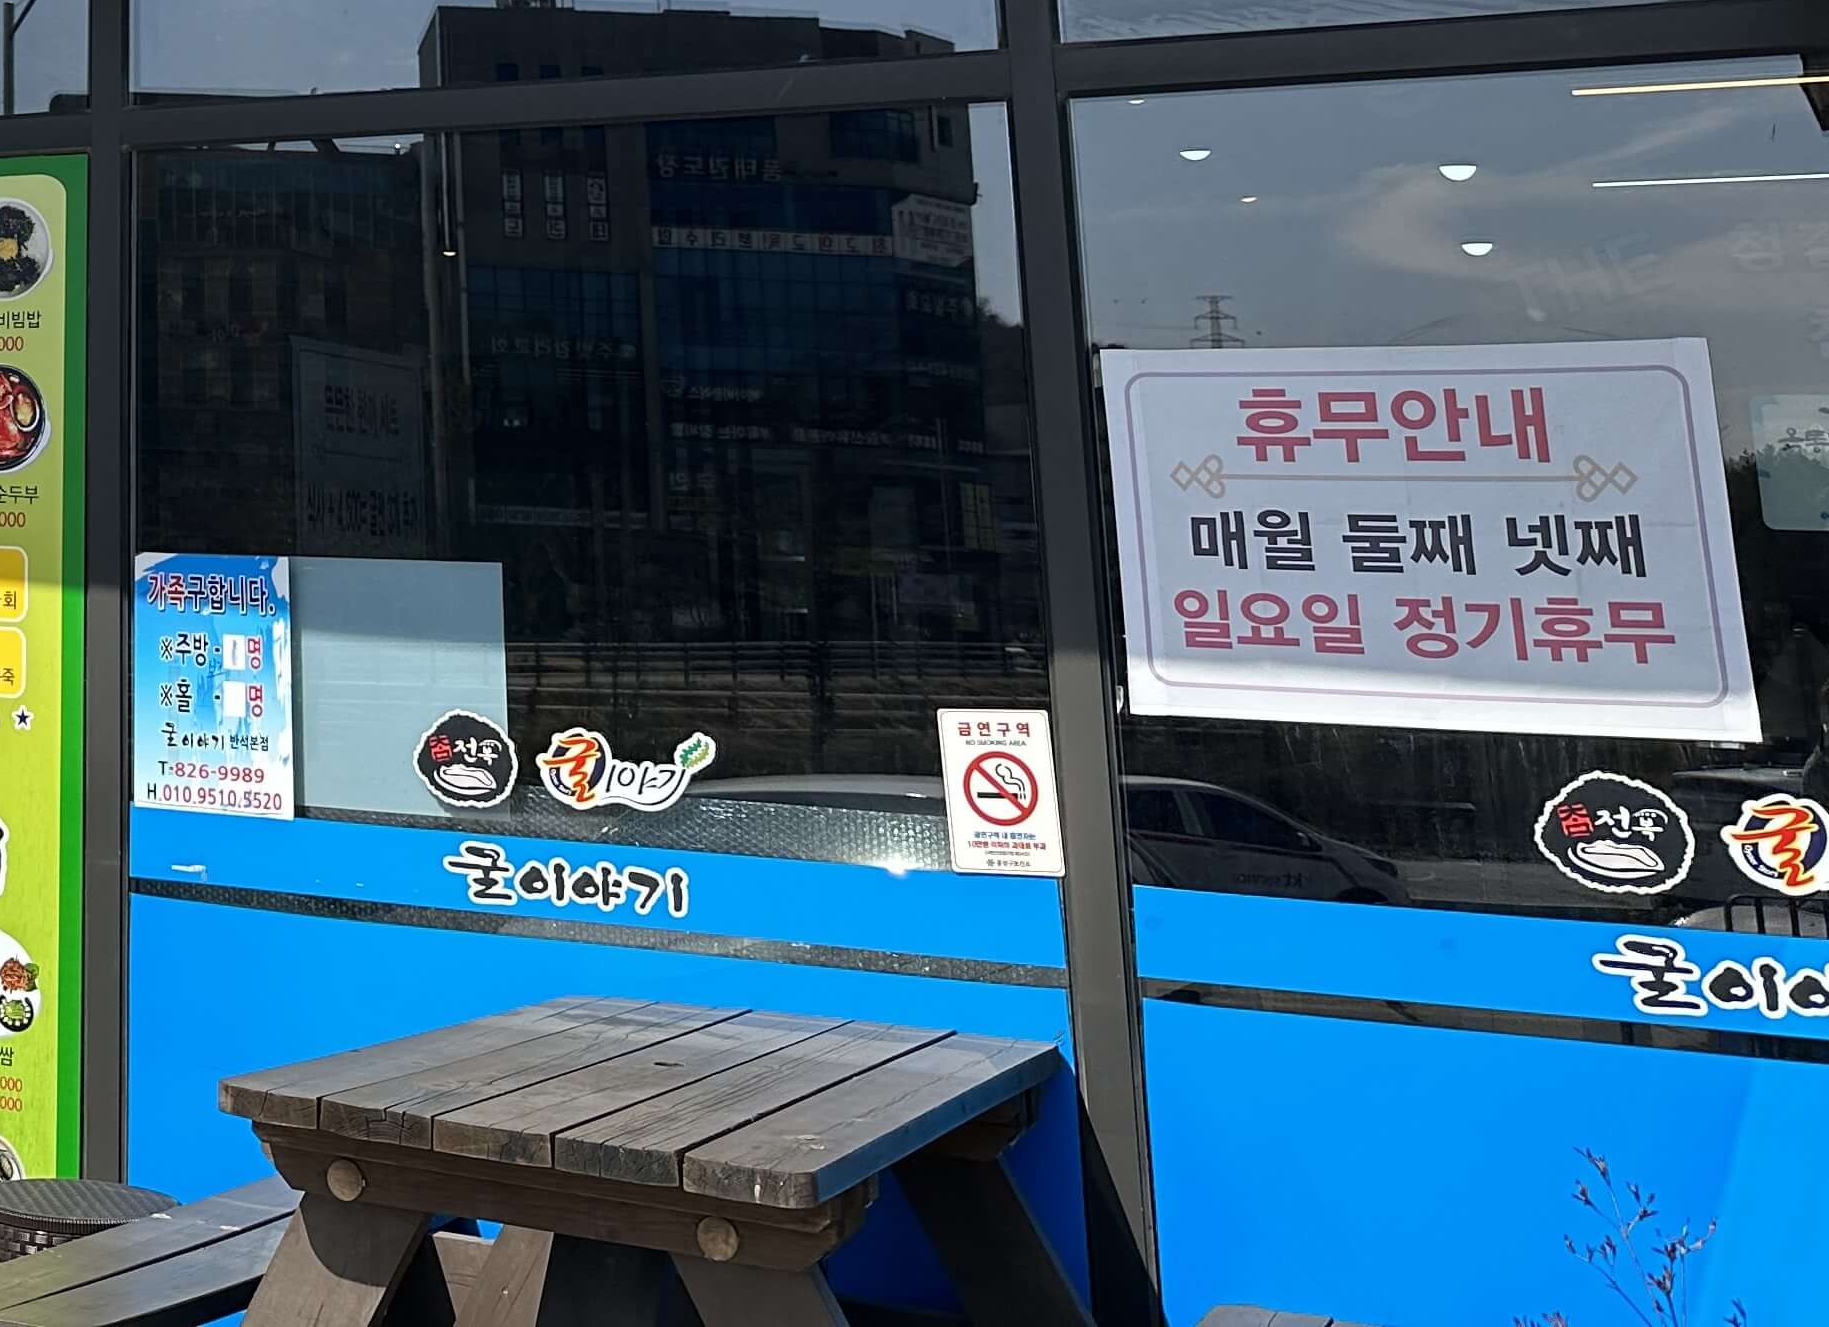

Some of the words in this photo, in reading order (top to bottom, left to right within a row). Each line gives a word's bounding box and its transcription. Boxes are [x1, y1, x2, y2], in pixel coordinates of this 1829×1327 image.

[1237, 386, 1551, 464] 휴무안내
[1191, 509, 1317, 572] 매월
[1342, 513, 1476, 576] 둘째
[1506, 513, 1648, 578] 넷째
[1174, 588, 1366, 656] 일요일
[1394, 595, 1676, 665] 정기휴무
[248, 637, 261, 669] 명
[249, 684, 263, 717] 명
[161, 722, 225, 751] 굴이야기
[229, 732, 269, 752] 반석본점
[958, 721, 1030, 737] 금연구역
[448, 845, 683, 912] 굴이야기
